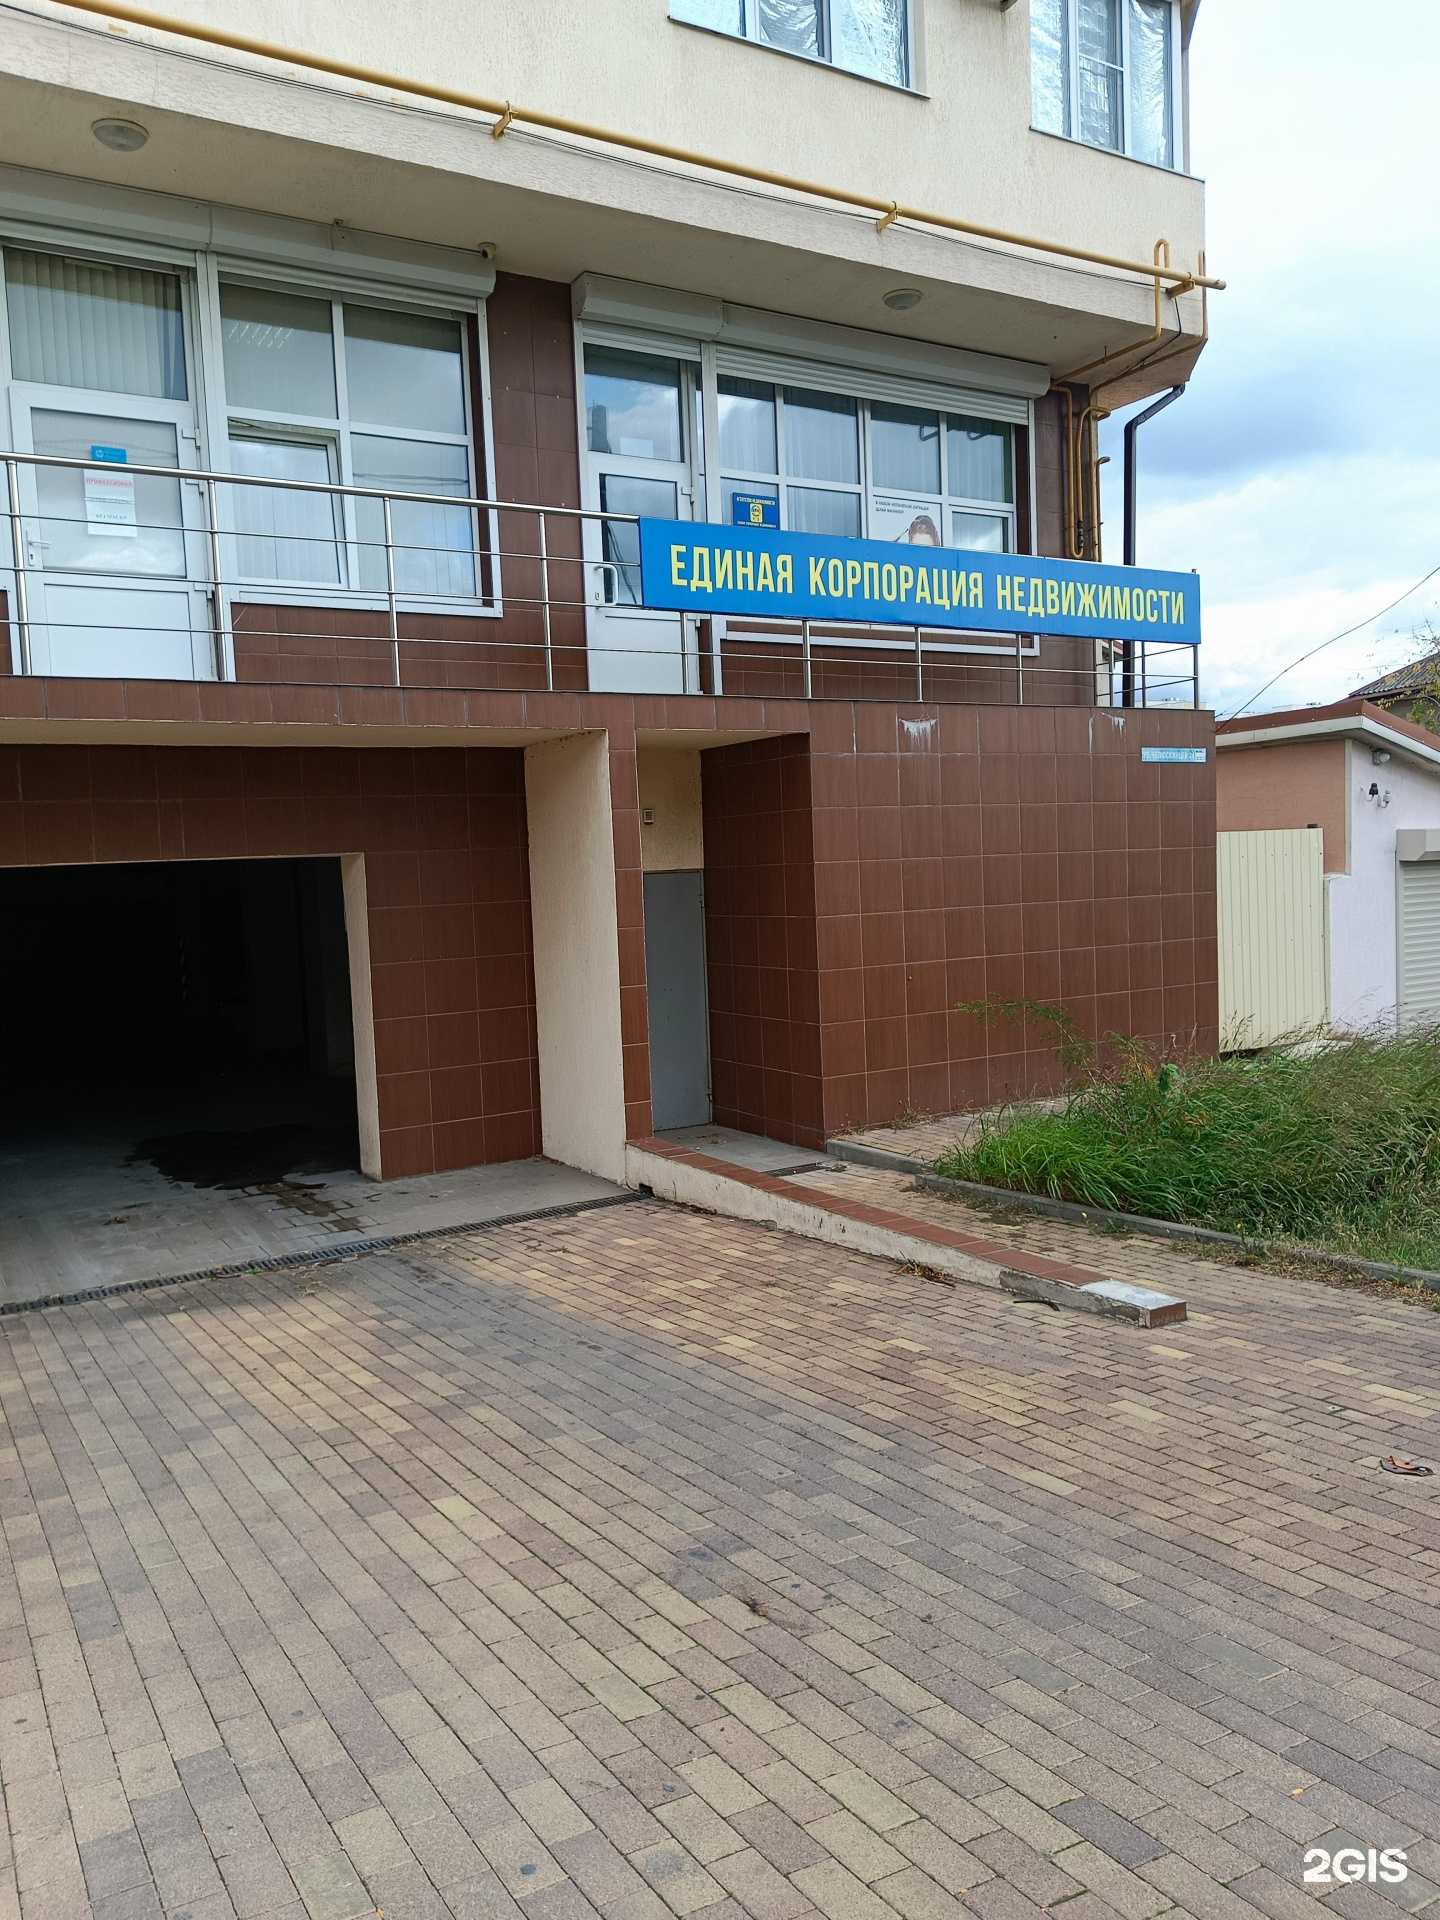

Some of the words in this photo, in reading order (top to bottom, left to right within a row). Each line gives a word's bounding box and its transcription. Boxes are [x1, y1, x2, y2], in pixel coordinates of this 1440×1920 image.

[670, 544, 793, 594] ЕДИНАЯ
[809, 557, 984, 611] КОРПОРАЦИЯ
[996, 574, 1185, 625] НЕДВИЖИМОСТИ
